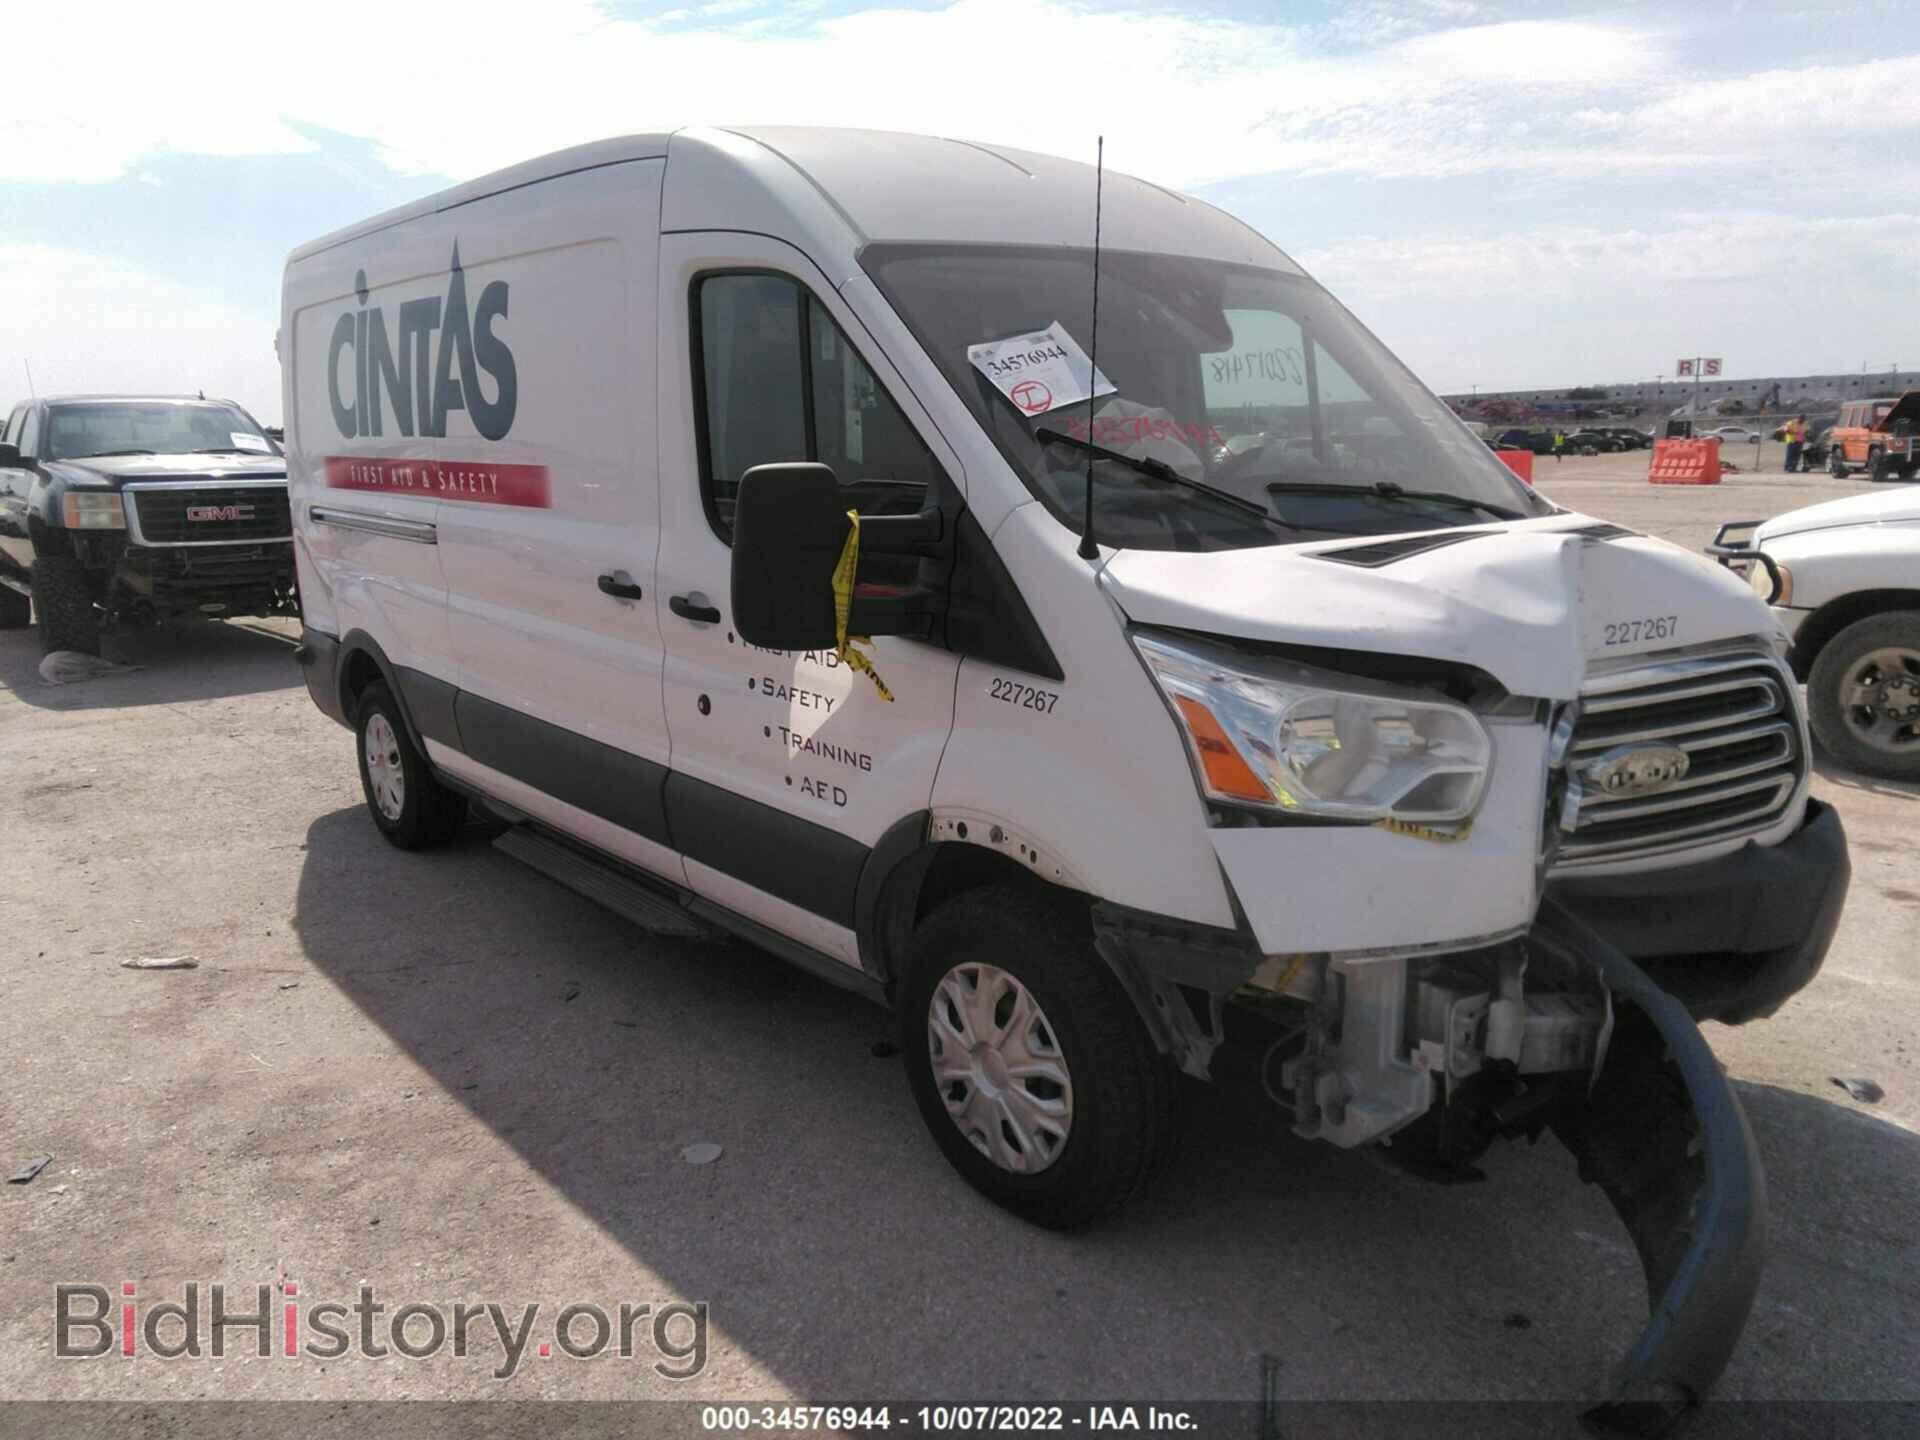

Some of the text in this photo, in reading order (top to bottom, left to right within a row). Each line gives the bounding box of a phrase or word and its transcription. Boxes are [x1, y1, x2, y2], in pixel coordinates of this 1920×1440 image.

[987, 345, 1068, 376] 34576944
[1680, 360, 1720, 375] R S
[351, 465, 384, 485] FIRST
[391, 467, 414, 487] AID
[438, 470, 498, 495] SAFETY
[187, 505, 256, 521] GMC
[1605, 616, 1678, 645] 227267
[804, 650, 839, 668] AID
[762, 678, 835, 713] SAFETY
[990, 678, 1059, 714] 227267
[778, 726, 872, 772] TRAINING
[800, 776, 848, 807] AED
